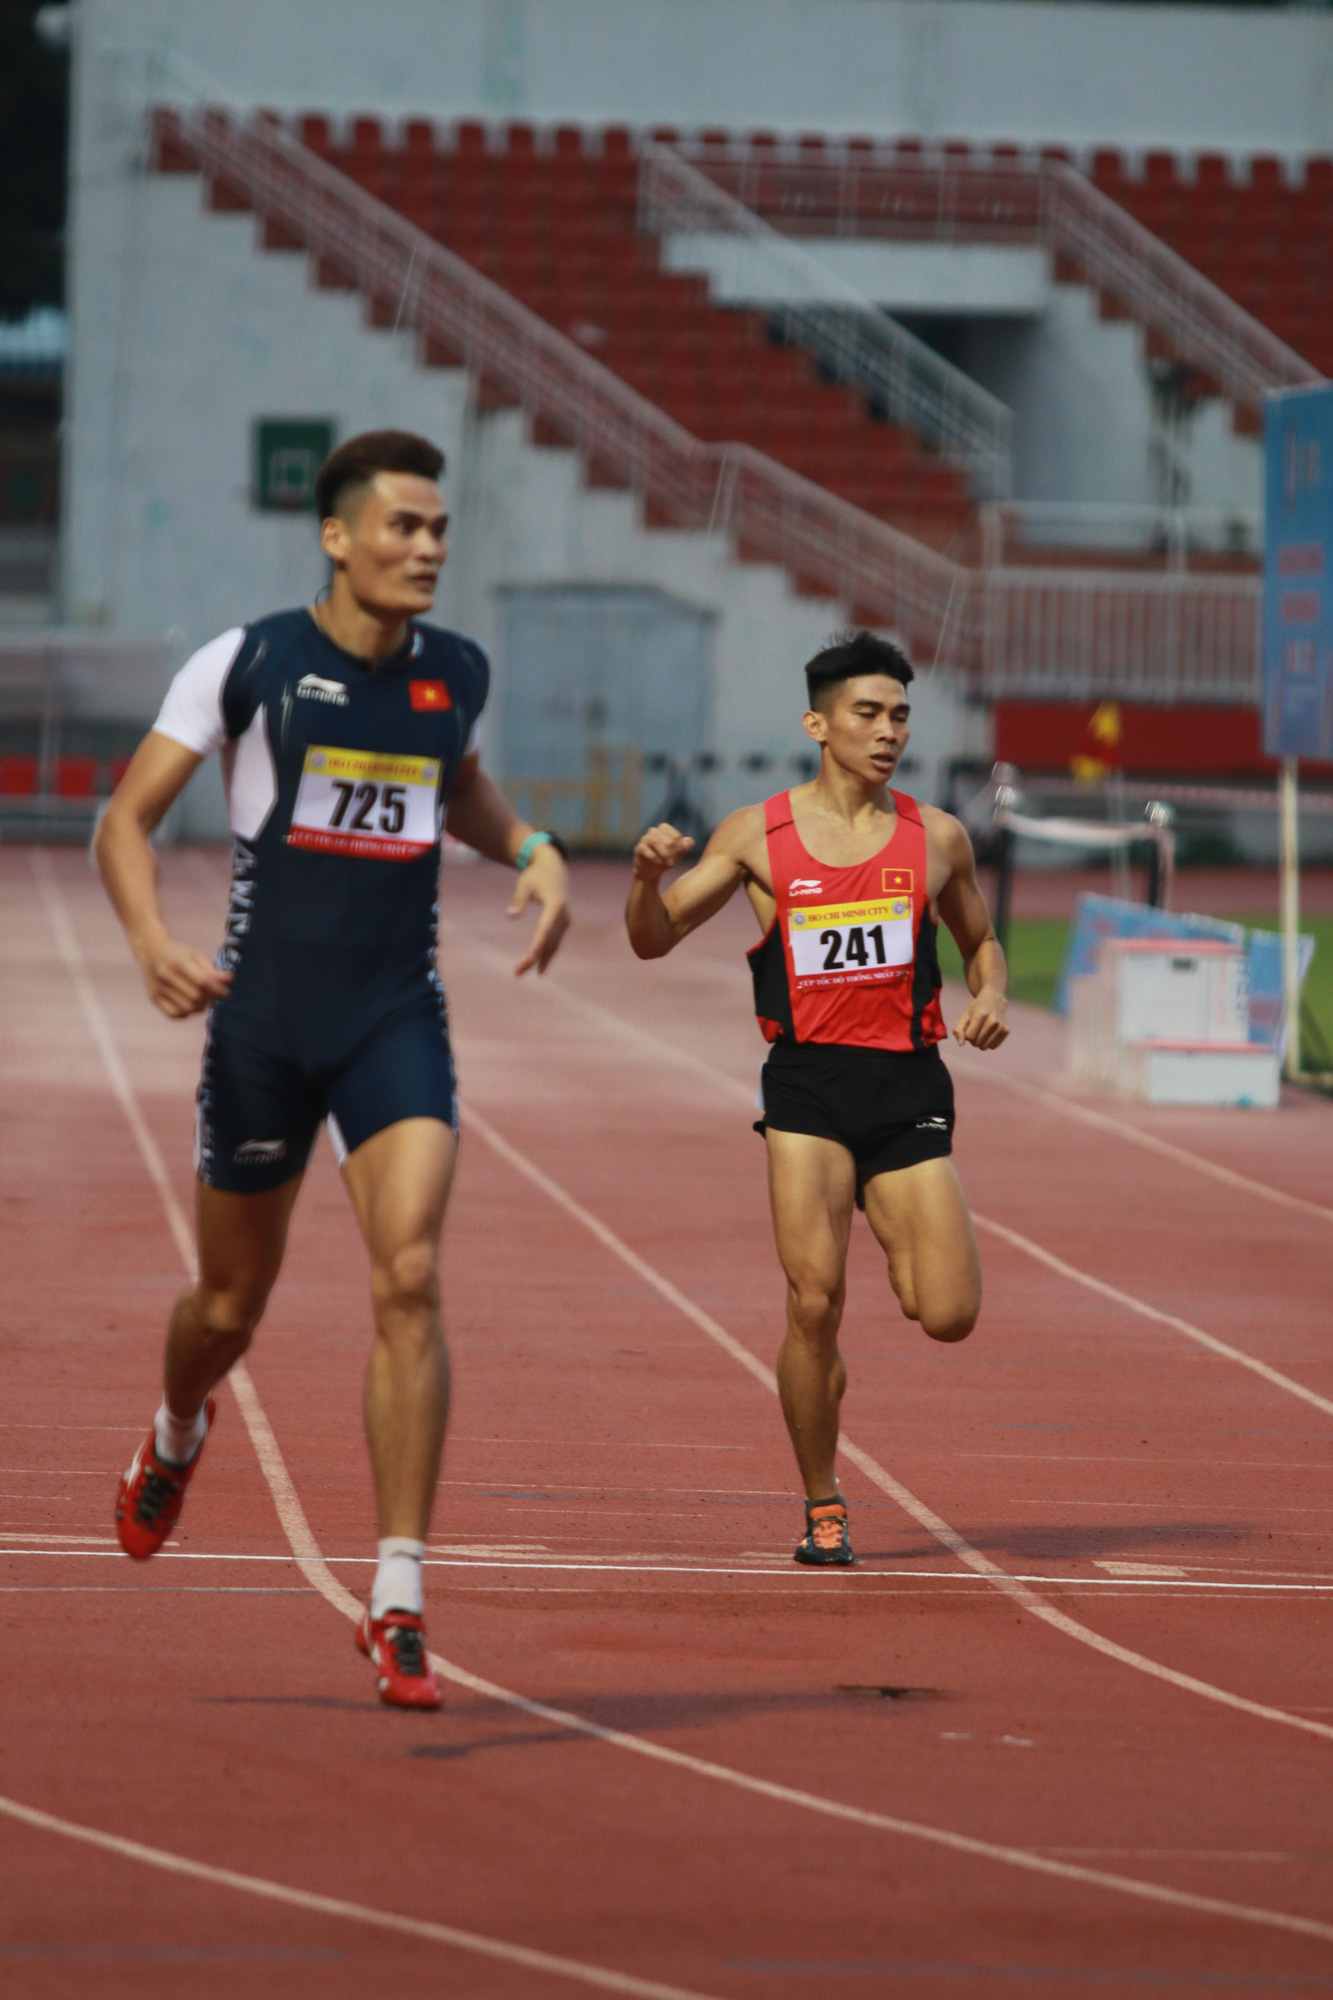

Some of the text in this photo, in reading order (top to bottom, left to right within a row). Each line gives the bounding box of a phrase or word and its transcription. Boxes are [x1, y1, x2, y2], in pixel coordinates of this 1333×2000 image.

[329, 780, 406, 833] 725
[823, 912, 840, 920] CHI
[842, 909, 866, 918] MINH
[867, 906, 888, 915] CITY
[820, 925, 886, 970] 241
